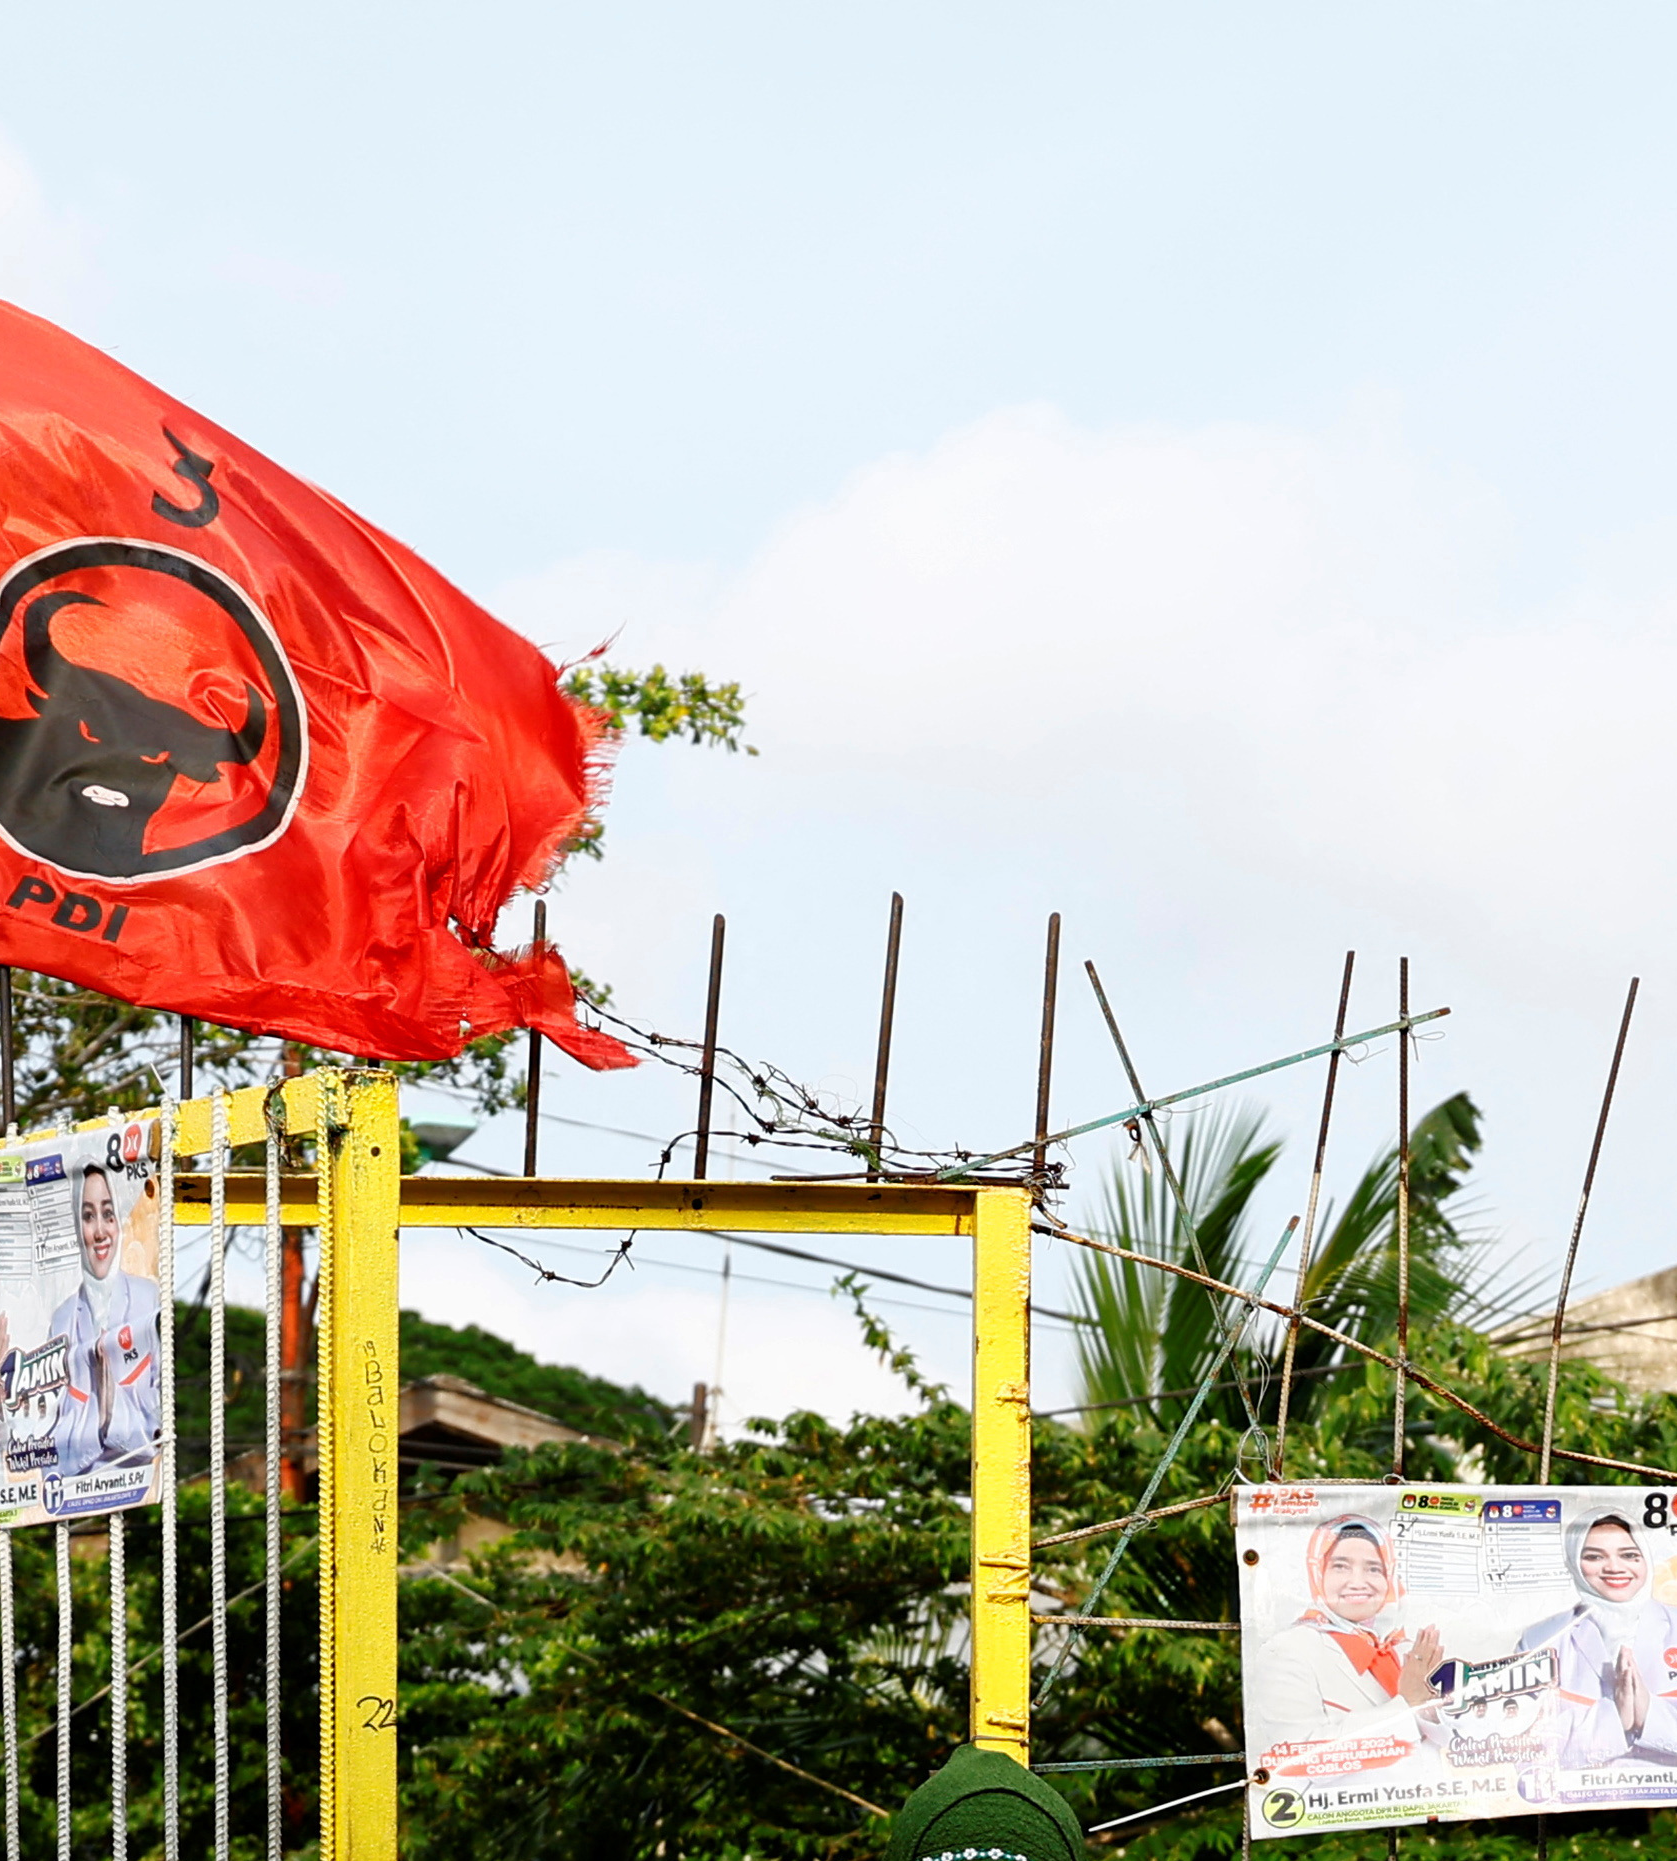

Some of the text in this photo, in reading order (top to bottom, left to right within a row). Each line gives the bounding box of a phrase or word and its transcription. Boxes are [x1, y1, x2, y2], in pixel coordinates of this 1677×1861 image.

[6, 875, 130, 943] PDI
[106, 1133, 122, 1171] 8
[126, 1162, 148, 1181] PKS
[123, 1348, 138, 1364] PKS
[17, 1348, 66, 1392] AMIN
[75, 1479, 93, 1494] Fitri
[128, 1470, 145, 1486] S.Pd
[0, 1488, 17, 1506] S.E,
[19, 1484, 37, 1500] M.E
[1418, 1495, 1429, 1508] 8
[1502, 1505, 1513, 1518] 8
[1643, 1492, 1668, 1529] 8
[1397, 1523, 1406, 1537] 2
[1462, 1660, 1552, 1700] AMIN
[356, 1695, 397, 1733] 22
[1273, 1745, 1289, 1756] 14
[1361, 1738, 1394, 1749] 2024
[1322, 1746, 1406, 1764] PERUBAHAN
[1306, 1761, 1362, 1775] COBLOS
[1581, 1773, 1613, 1786] Fitri
[1616, 1770, 1677, 1786] Aryanti,
[1309, 1778, 1506, 1810] Hj. Ermi Yusfa S.E, M.E
[1634, 1787, 1669, 1795] JAKARTA
[1271, 1793, 1296, 1822] 2
[1307, 1812, 1334, 1822] CALON
[1336, 1809, 1372, 1819] ANGGOTA
[1373, 1807, 1391, 1816] DPR
